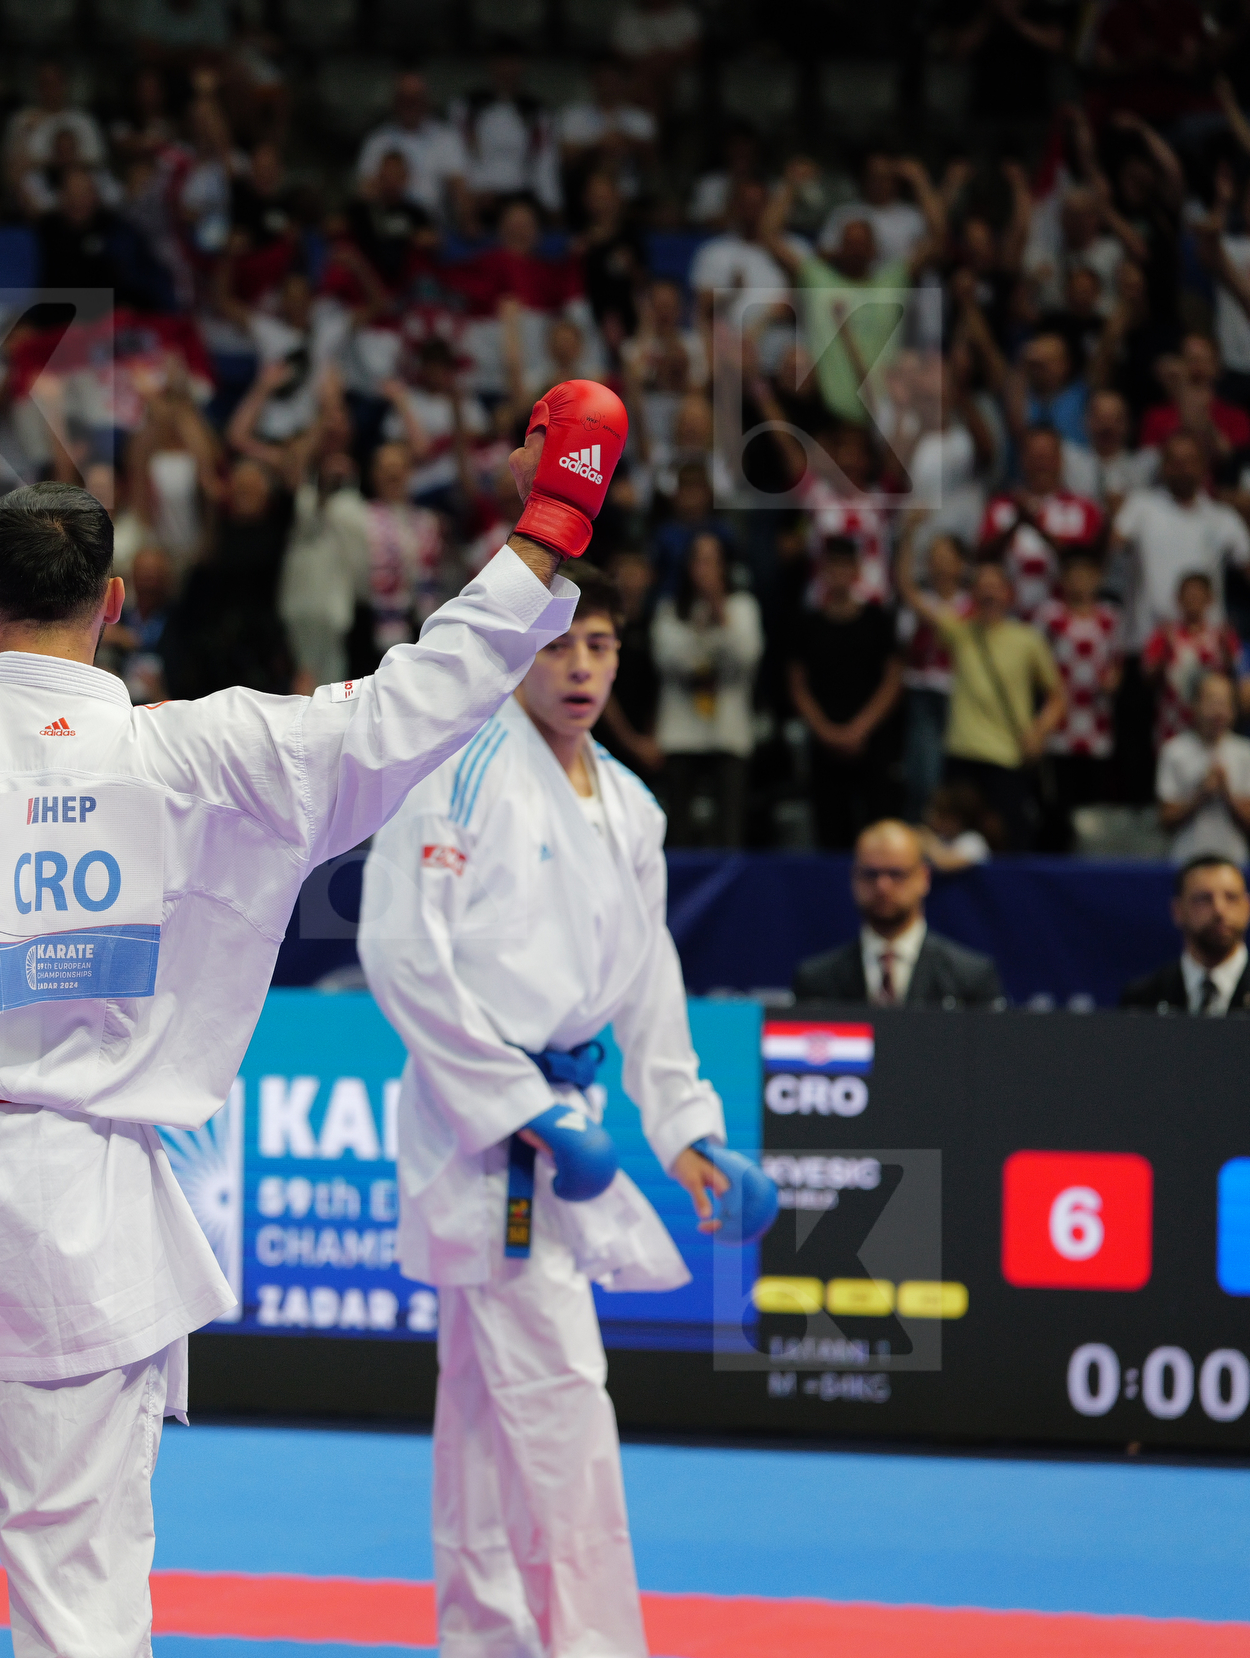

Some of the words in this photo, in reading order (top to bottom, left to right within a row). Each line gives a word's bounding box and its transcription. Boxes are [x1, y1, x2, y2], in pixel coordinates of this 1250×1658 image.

[559, 456, 603, 485] adidas
[39, 729, 76, 737] adidas
[13, 849, 122, 915] CRO
[37, 943, 95, 959] KARATE
[37, 962, 52, 970] 59th
[53, 962, 92, 970] EUROPEAN
[37, 970, 93, 979] CHAMPIONSHIPS
[59, 981, 79, 990] 2024
[765, 1074, 869, 1117] CRO
[1049, 1185, 1106, 1262] 6
[257, 1283, 400, 1331] ZADAR
[1067, 1342, 1250, 1423] 0:00
